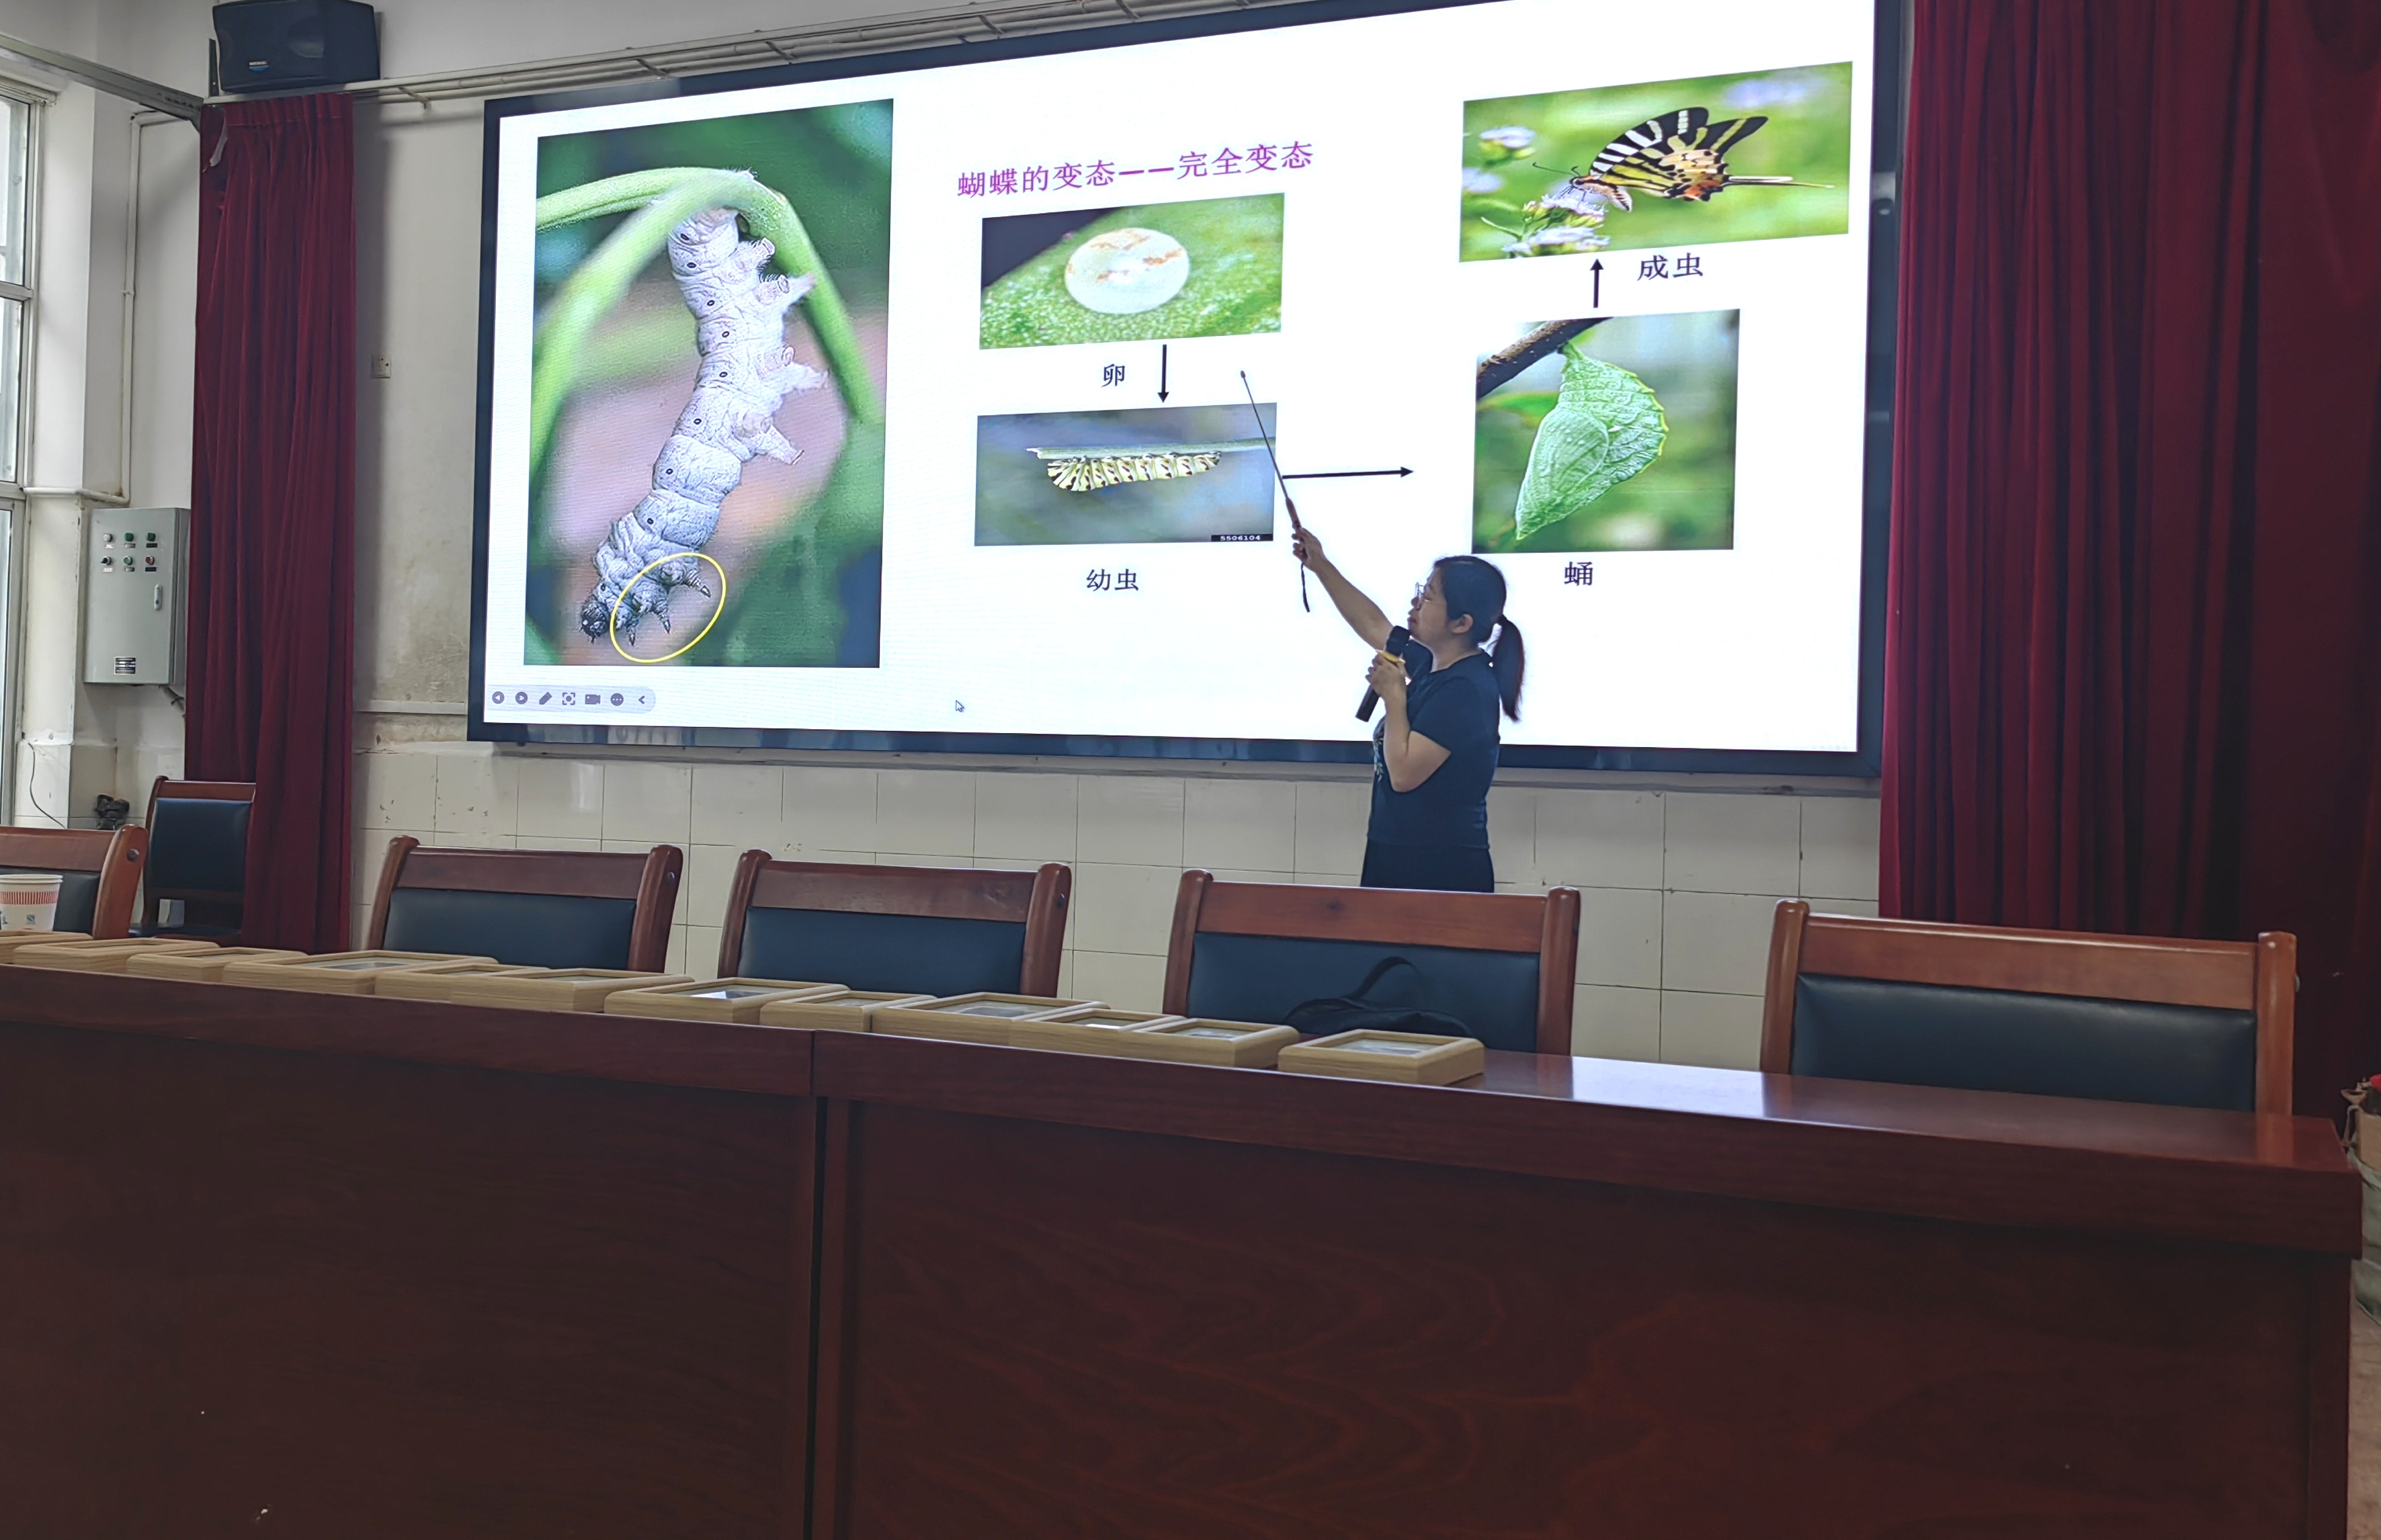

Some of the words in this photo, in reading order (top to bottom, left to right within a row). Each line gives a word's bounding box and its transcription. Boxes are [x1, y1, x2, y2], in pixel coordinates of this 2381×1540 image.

[1636, 252, 1704, 282] 成虫
[1101, 363, 1126, 388] 卵
[1086, 568, 1139, 592] 幼虫
[1564, 561, 1593, 587] 蛹
